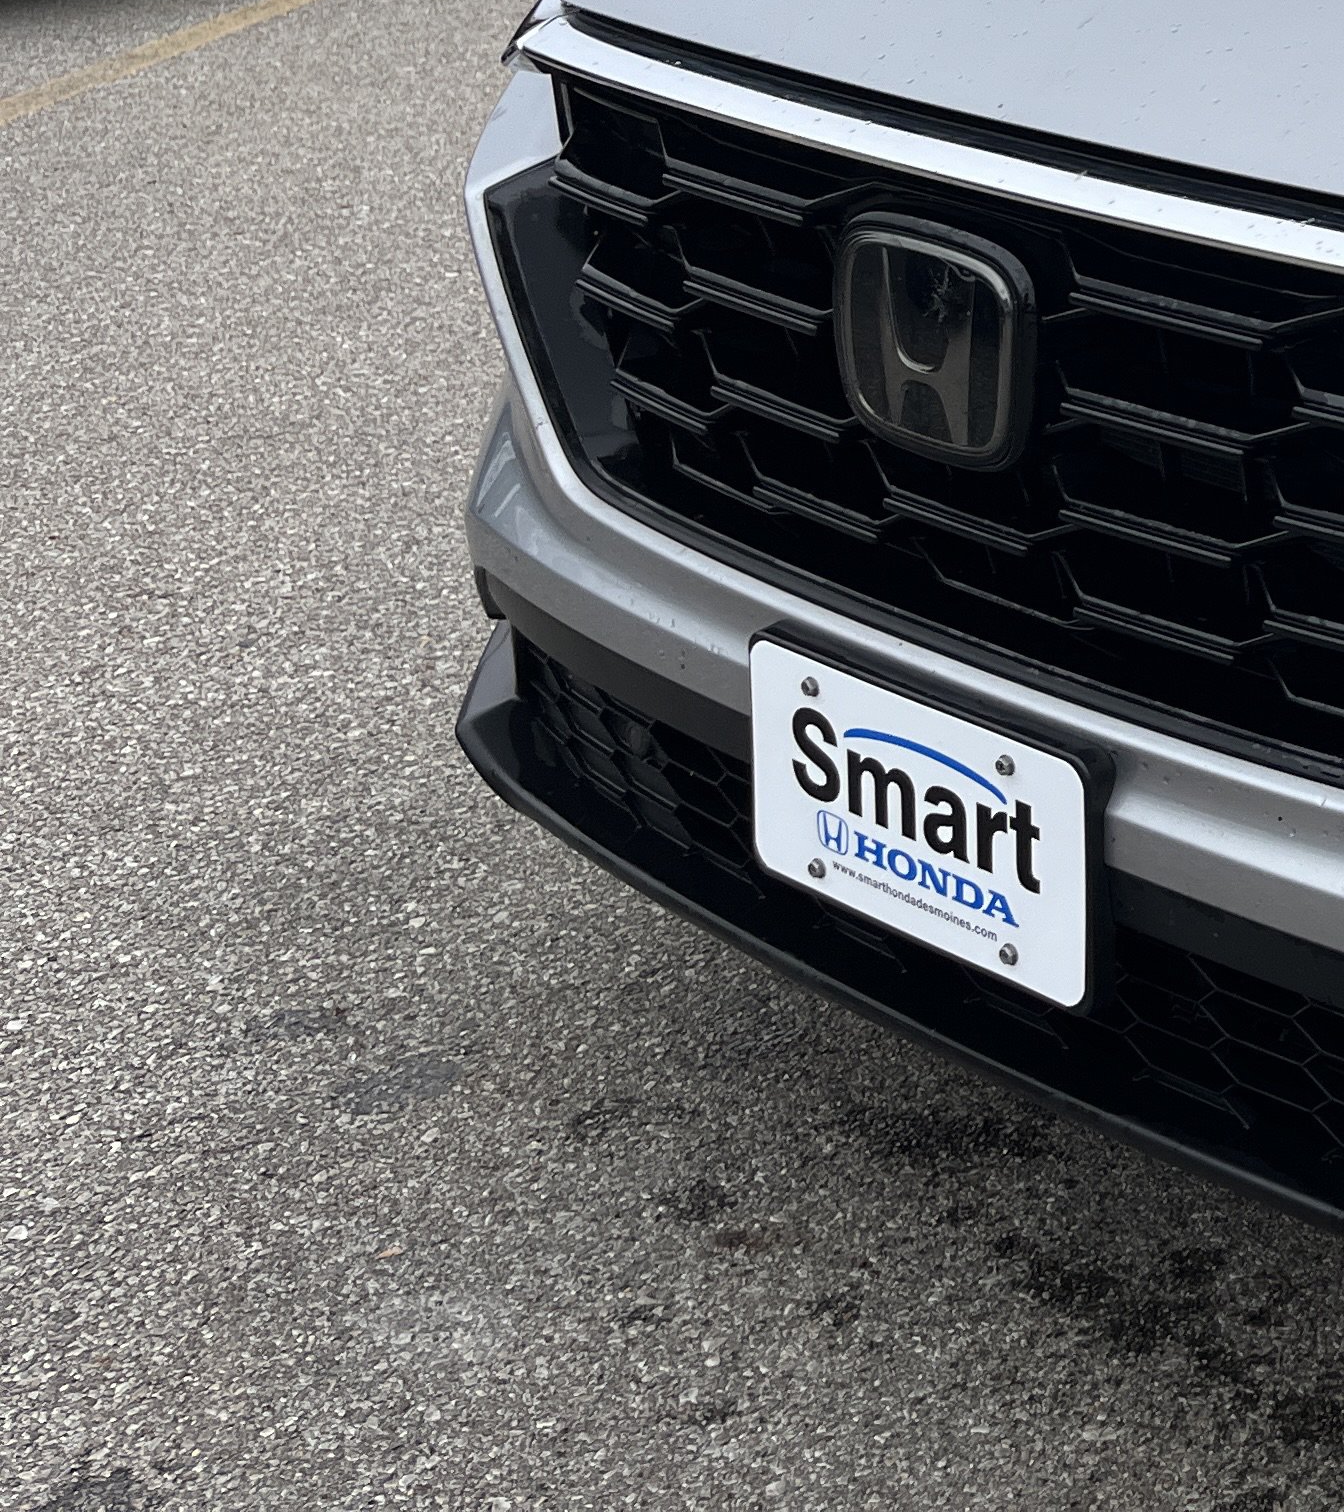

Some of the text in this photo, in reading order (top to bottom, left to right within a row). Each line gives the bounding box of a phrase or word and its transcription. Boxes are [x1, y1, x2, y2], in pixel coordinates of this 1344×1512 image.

[792, 707, 1041, 894] Smart
[832, 860, 998, 942] www.smarthondadesmoines.com
[854, 831, 1020, 928] HONDA
